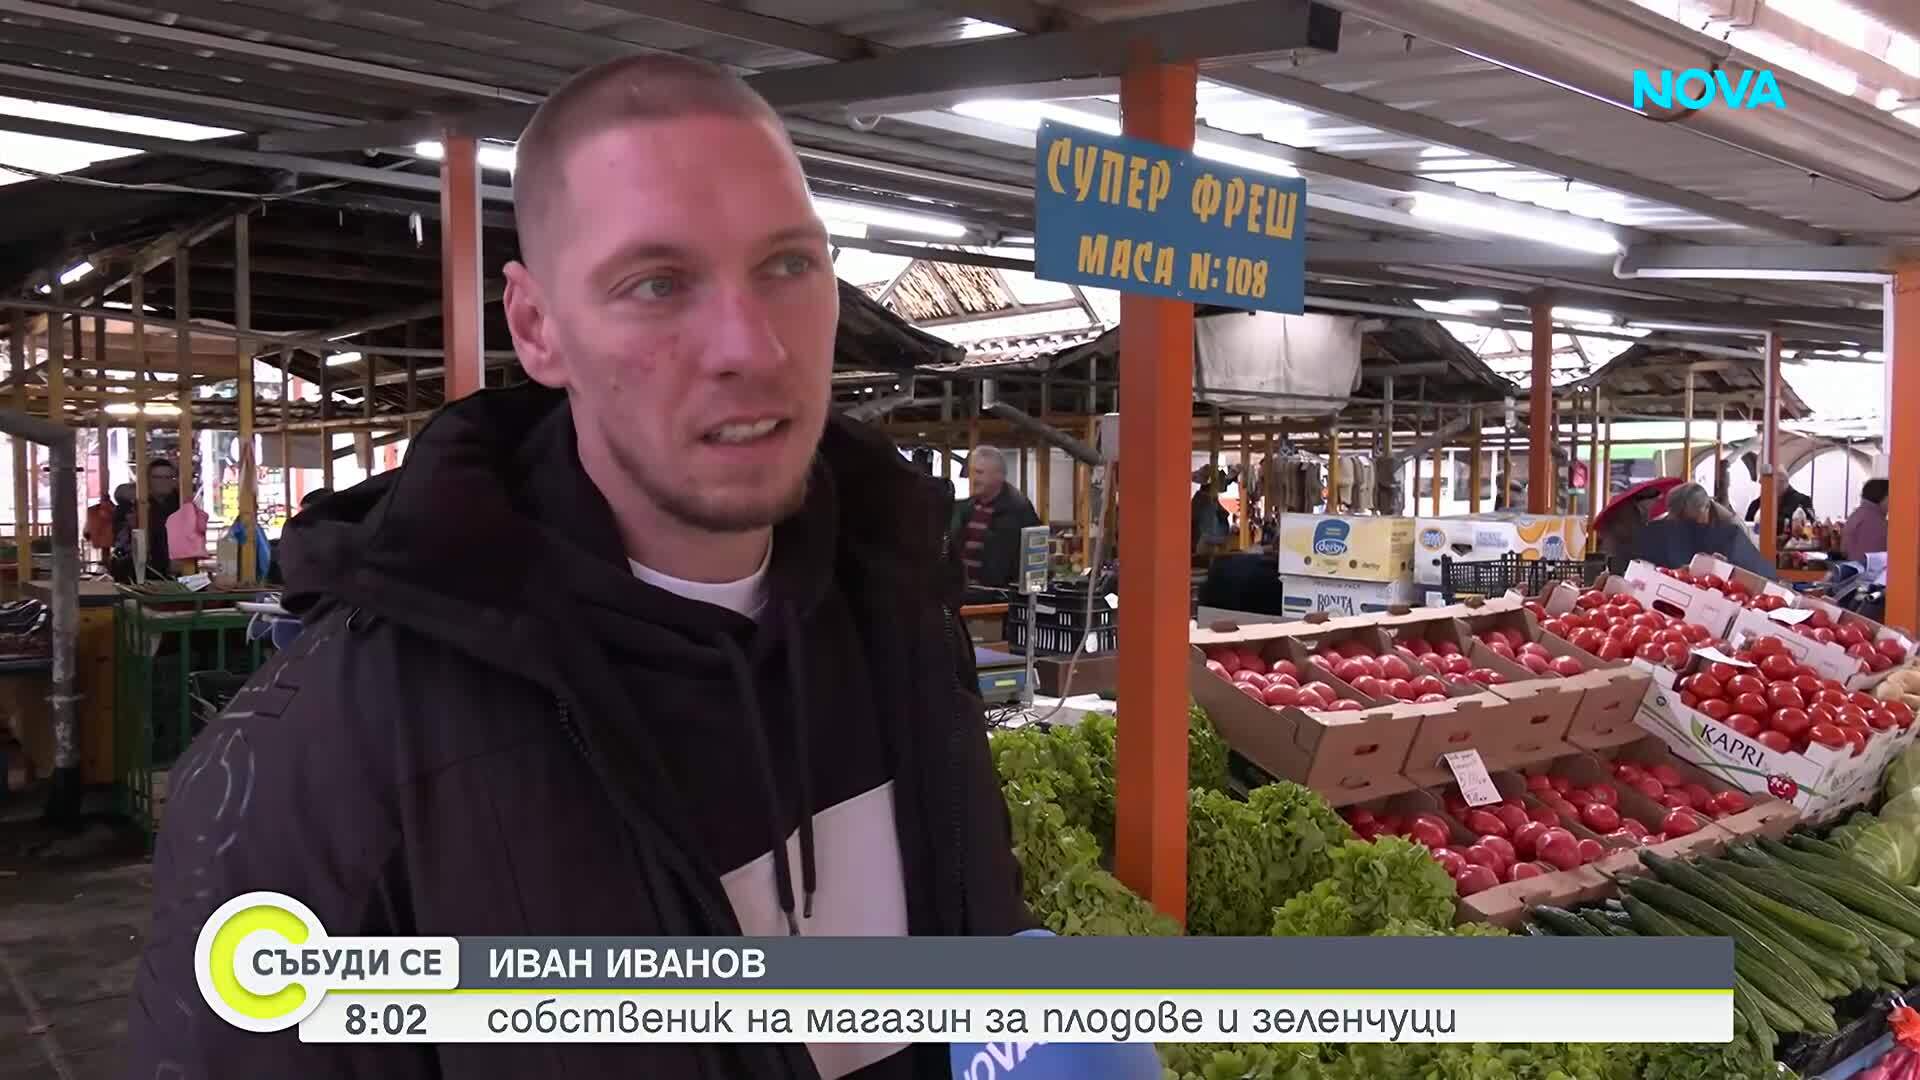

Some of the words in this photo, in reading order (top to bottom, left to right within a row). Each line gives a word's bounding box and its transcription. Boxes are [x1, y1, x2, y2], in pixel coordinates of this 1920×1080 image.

[1047, 137, 1171, 212] СУПЕР
[1191, 173, 1297, 240] ФРЕШ
[1077, 234, 1175, 286] МАСА
[1318, 540, 1346, 553] derby
[1701, 724, 1764, 767] KAPRI
